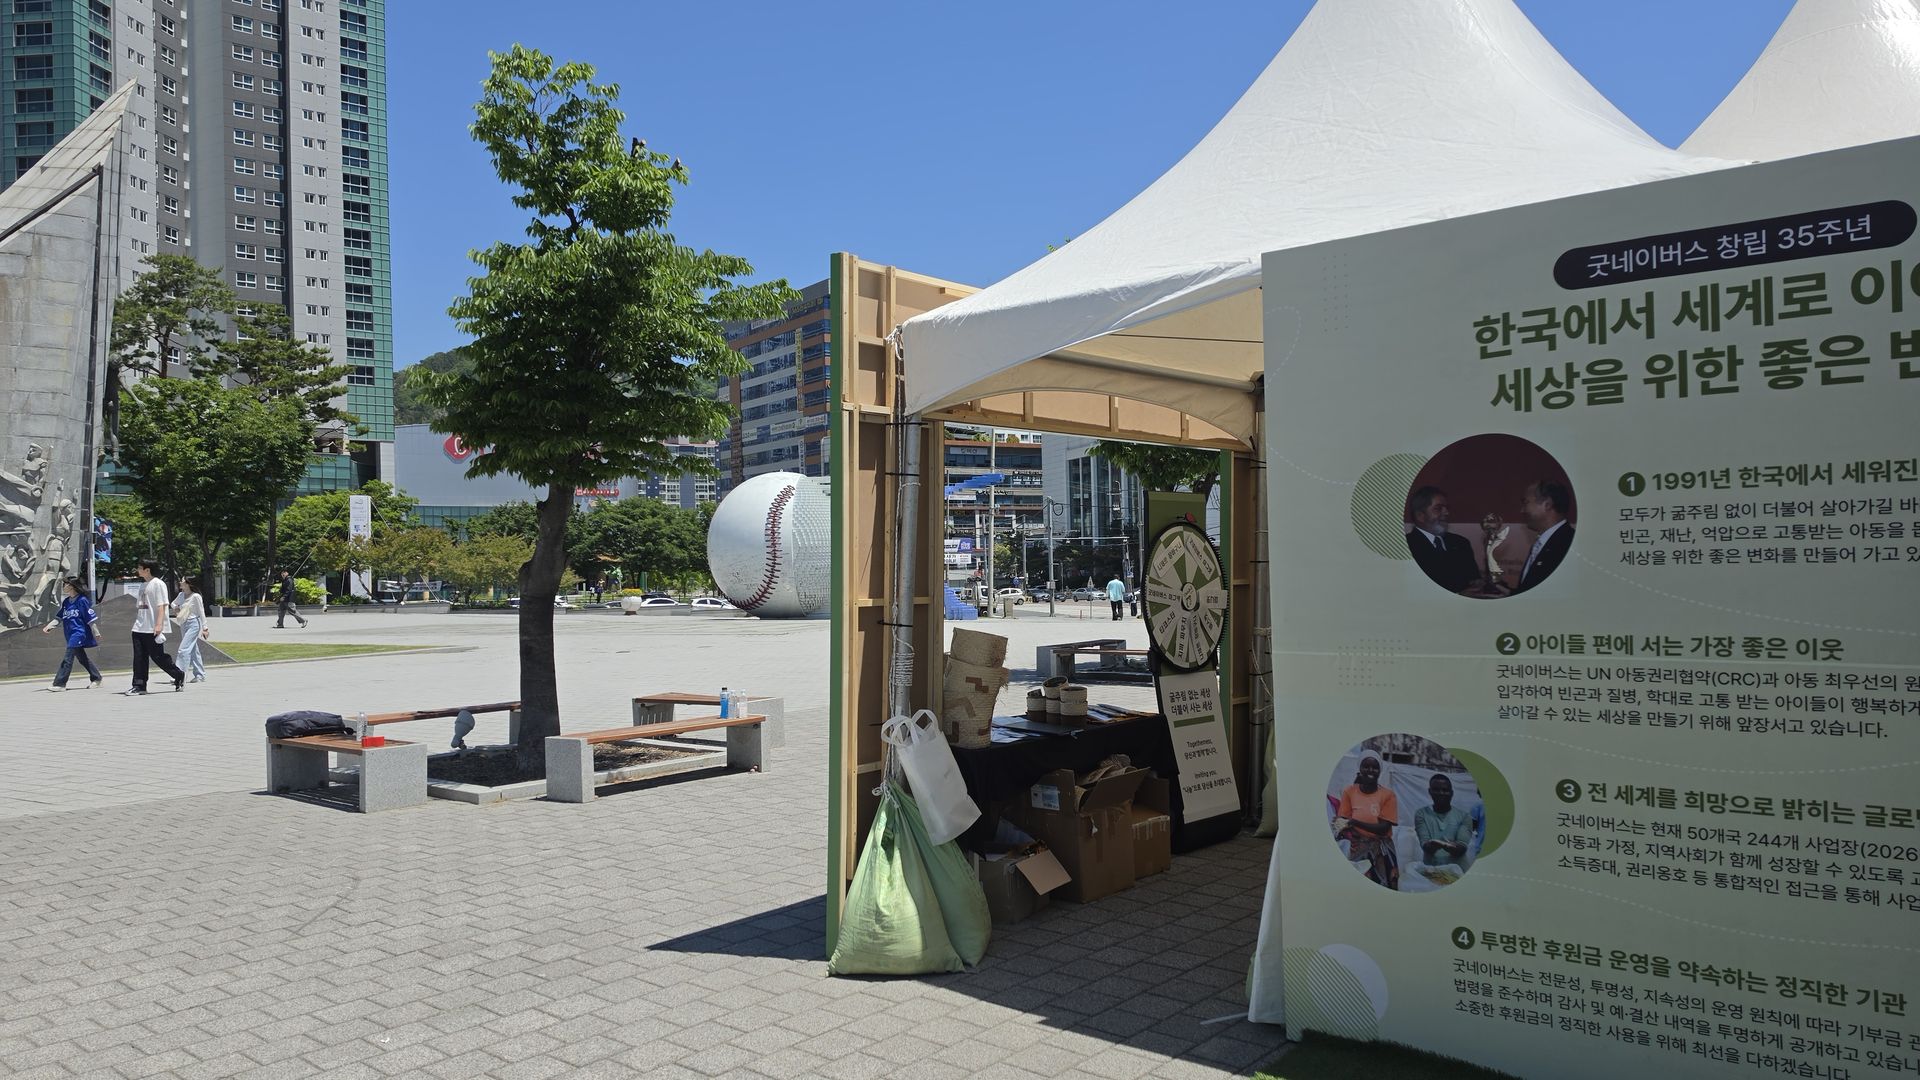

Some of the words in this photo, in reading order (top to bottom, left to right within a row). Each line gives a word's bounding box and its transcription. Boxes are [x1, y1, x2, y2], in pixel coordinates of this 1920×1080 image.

[1586, 240, 1709, 280] 굿네이버스
[1716, 229, 1769, 261] 창립
[1777, 214, 1872, 251] 35주년
[1472, 291, 1657, 360] 한국에서
[1671, 272, 1833, 333] 세계로
[1490, 357, 1629, 414] 세상을
[1642, 343, 1745, 399] 위한
[1758, 333, 1872, 391] 좋은
[1652, 467, 1732, 491] 1991년
[1738, 462, 1833, 489] 한국에서
[1841, 458, 1920, 484] 세워진
[1619, 506, 1666, 522] 모두가
[1671, 504, 1718, 521] 굶주림
[1724, 502, 1757, 519] 없이
[1763, 500, 1814, 518] 더불어
[1820, 497, 1893, 516] 살아가길
[1620, 528, 1655, 546] 빈곤,
[1659, 527, 1697, 545] 재난,
[1702, 525, 1768, 543] 억압으로
[1774, 523, 1844, 541] 고통받는
[1849, 521, 1905, 539] 아동을
[1620, 550, 1667, 566] 세상을
[1671, 549, 1703, 565] 위한
[1708, 549, 1742, 564] 좋은
[1747, 547, 1799, 564] 변화를
[1803, 546, 1856, 563] 만들어
[1863, 546, 1900, 563] 가고
[1526, 634, 1587, 654] 아이들
[1592, 635, 1635, 656] 편에
[1640, 635, 1685, 657] 서는
[1690, 636, 1735, 658] 가장
[1741, 637, 1789, 660] 좋은
[1796, 637, 1845, 661] 이웃
[1497, 664, 1582, 681] 굿네이버스는
[1587, 667, 1610, 681] UN
[1616, 666, 1779, 688] 아동권리협약(CRC)과
[1784, 672, 1819, 689] 아동
[1824, 672, 1899, 692] 최우선의
[1497, 684, 1554, 700] 입각하여
[1558, 686, 1603, 702] 빈곤과
[1607, 687, 1641, 706] 질병,
[1646, 688, 1694, 707] 학대로
[1699, 691, 1731, 708] 고통
[1736, 692, 1770, 710] 받는
[1775, 693, 1845, 713] 아이들이
[1497, 704, 1540, 721] 살아갈
[1543, 707, 1558, 722] 수
[1562, 707, 1592, 724] 있는
[1596, 707, 1642, 726] 세상을
[1646, 710, 1694, 730] 만들기
[1698, 713, 1731, 732] 위해
[1736, 715, 1805, 735] 앞장서고
[1810, 719, 1888, 739] 있습니다.
[1588, 782, 1607, 803] 전
[1613, 785, 1678, 810] 세계를
[1684, 790, 1775, 817] 희망으로
[1782, 798, 1856, 825] 밝히는
[1863, 804, 1920, 830] 글로
[1557, 812, 1647, 836] 굿네이버스는
[1651, 821, 1682, 840] 현재
[1687, 826, 1742, 845] 50개국
[1747, 831, 1799, 850] 244개
[1557, 833, 1601, 852] 아동과
[1606, 838, 1640, 858] 가정,
[1645, 843, 1725, 866] 지역사회가
[1729, 851, 1763, 870] 함께
[1768, 855, 1820, 876] 성장할
[1825, 861, 1843, 878] 수
[1849, 863, 1904, 885] 있도록
[1557, 854, 1621, 879] 소득증대,
[1626, 861, 1688, 884] 권리옹호
[1693, 870, 1708, 886] 등
[1713, 872, 1780, 896] 통합적인
[1785, 879, 1839, 901] 접근을
[1844, 886, 1881, 907] 통해
[1480, 932, 1537, 956] 투명한
[1543, 940, 1602, 967] 후원금
[1608, 950, 1671, 978] 운영을
[1679, 959, 1769, 993] 약속하는
[1775, 975, 1848, 1007] 정직한
[1856, 988, 1908, 1017] 기관
[1453, 958, 1533, 983] 굿네이버스는
[1538, 969, 1585, 994] 전문성,
[1590, 979, 1638, 1004] 투명성,
[1644, 988, 1706, 1014] 지속성의
[1712, 1000, 1743, 1020] 운영
[1749, 1006, 1800, 1030] 원칙에
[1806, 1017, 1841, 1037] 따라
[1848, 1024, 1902, 1048] 기부금
[1454, 978, 1493, 997] 법령을
[1498, 985, 1554, 1007] 준수하며
[1558, 995, 1586, 1013] 감사
[1591, 1001, 1606, 1017] 및
[1664, 1013, 1711, 1036] 내역을
[1717, 1023, 1784, 1050] 투명하게
[1789, 1036, 1861, 1063] 공개하고
[1455, 999, 1495, 1018] 소중한
[1499, 1006, 1554, 1029] 후원금의
[1559, 1016, 1602, 1037] 정직한
[1606, 1025, 1651, 1047] 사용을
[1656, 1034, 1687, 1054] 위해
[1692, 1040, 1741, 1064] 최선을
